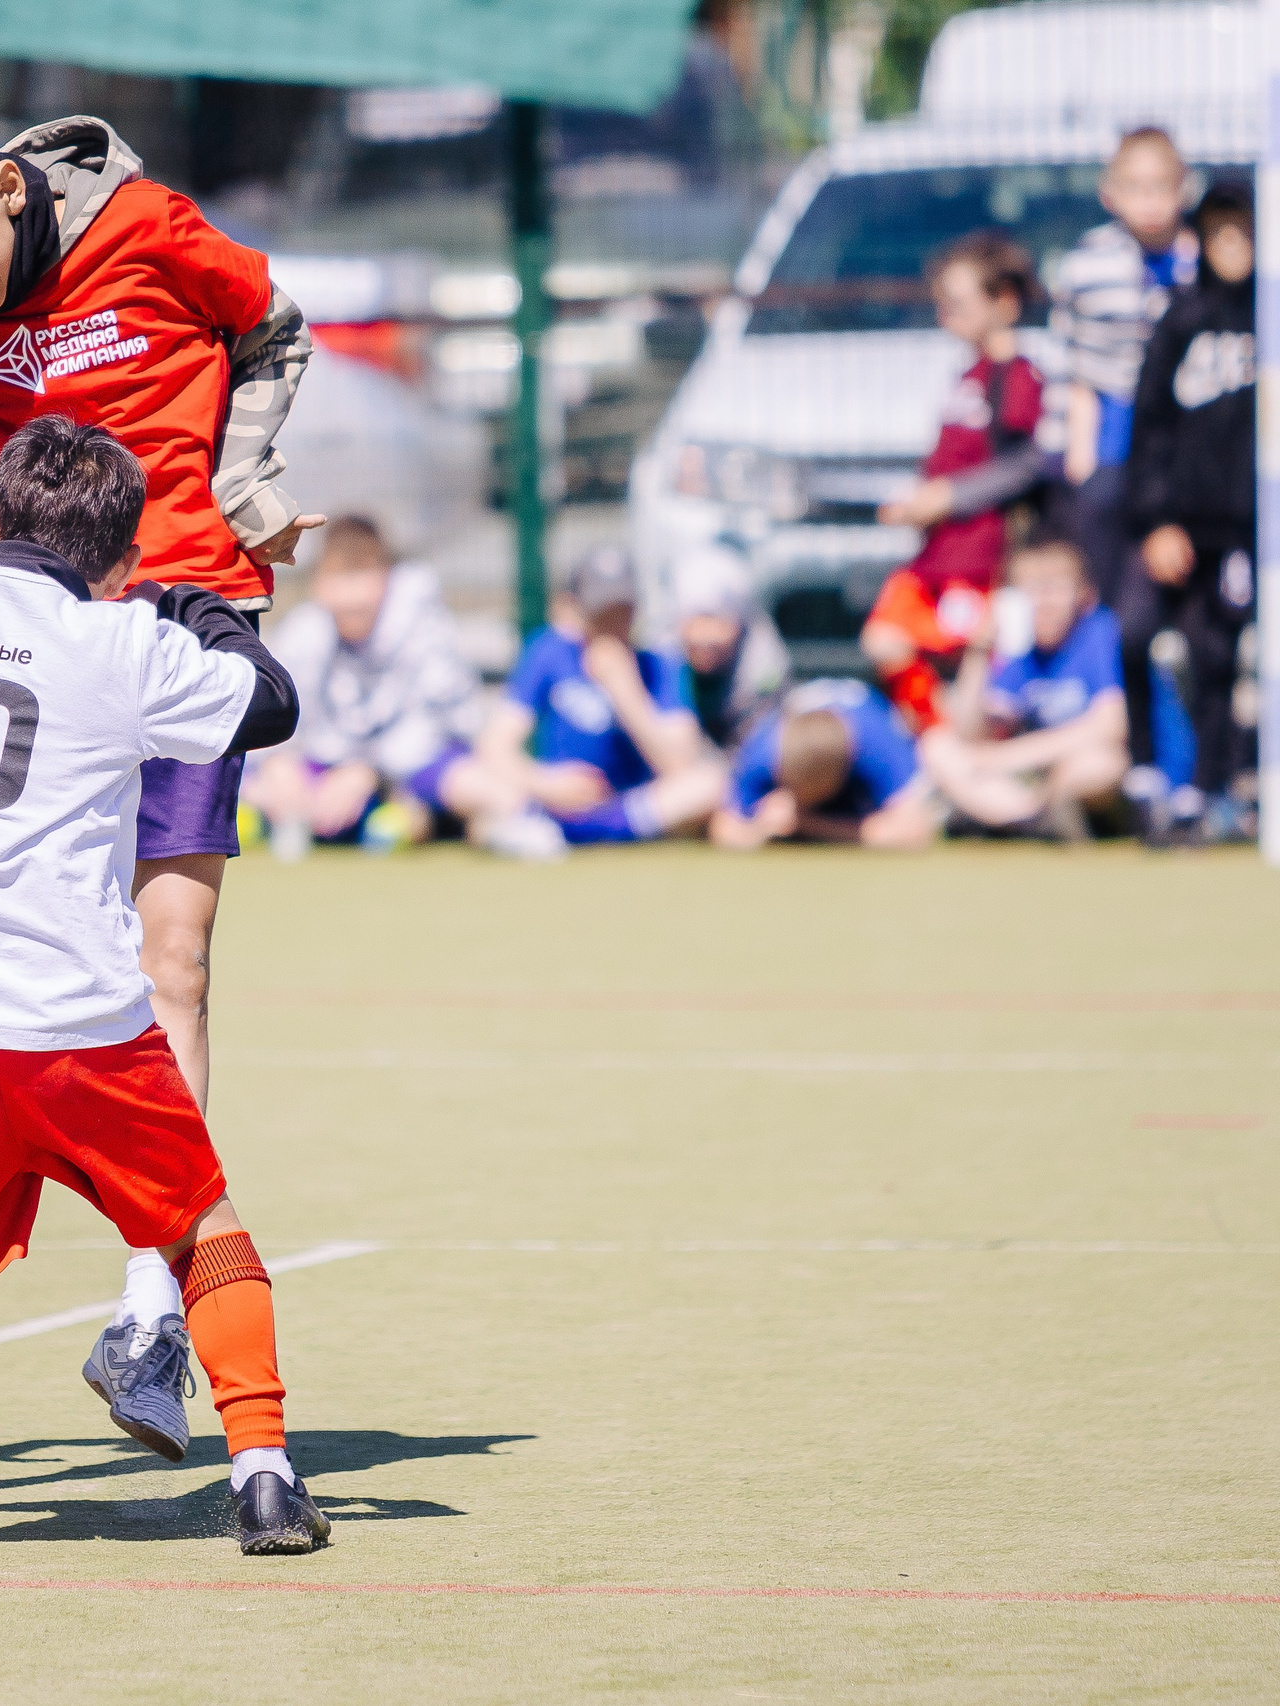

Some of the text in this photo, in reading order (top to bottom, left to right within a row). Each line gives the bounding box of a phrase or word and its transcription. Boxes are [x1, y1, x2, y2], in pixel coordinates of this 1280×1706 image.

[34, 309, 118, 346] РУССКАЯ
[40, 325, 119, 361] МЕДНАЯ
[46, 335, 150, 378] КОМПАНИЯ
